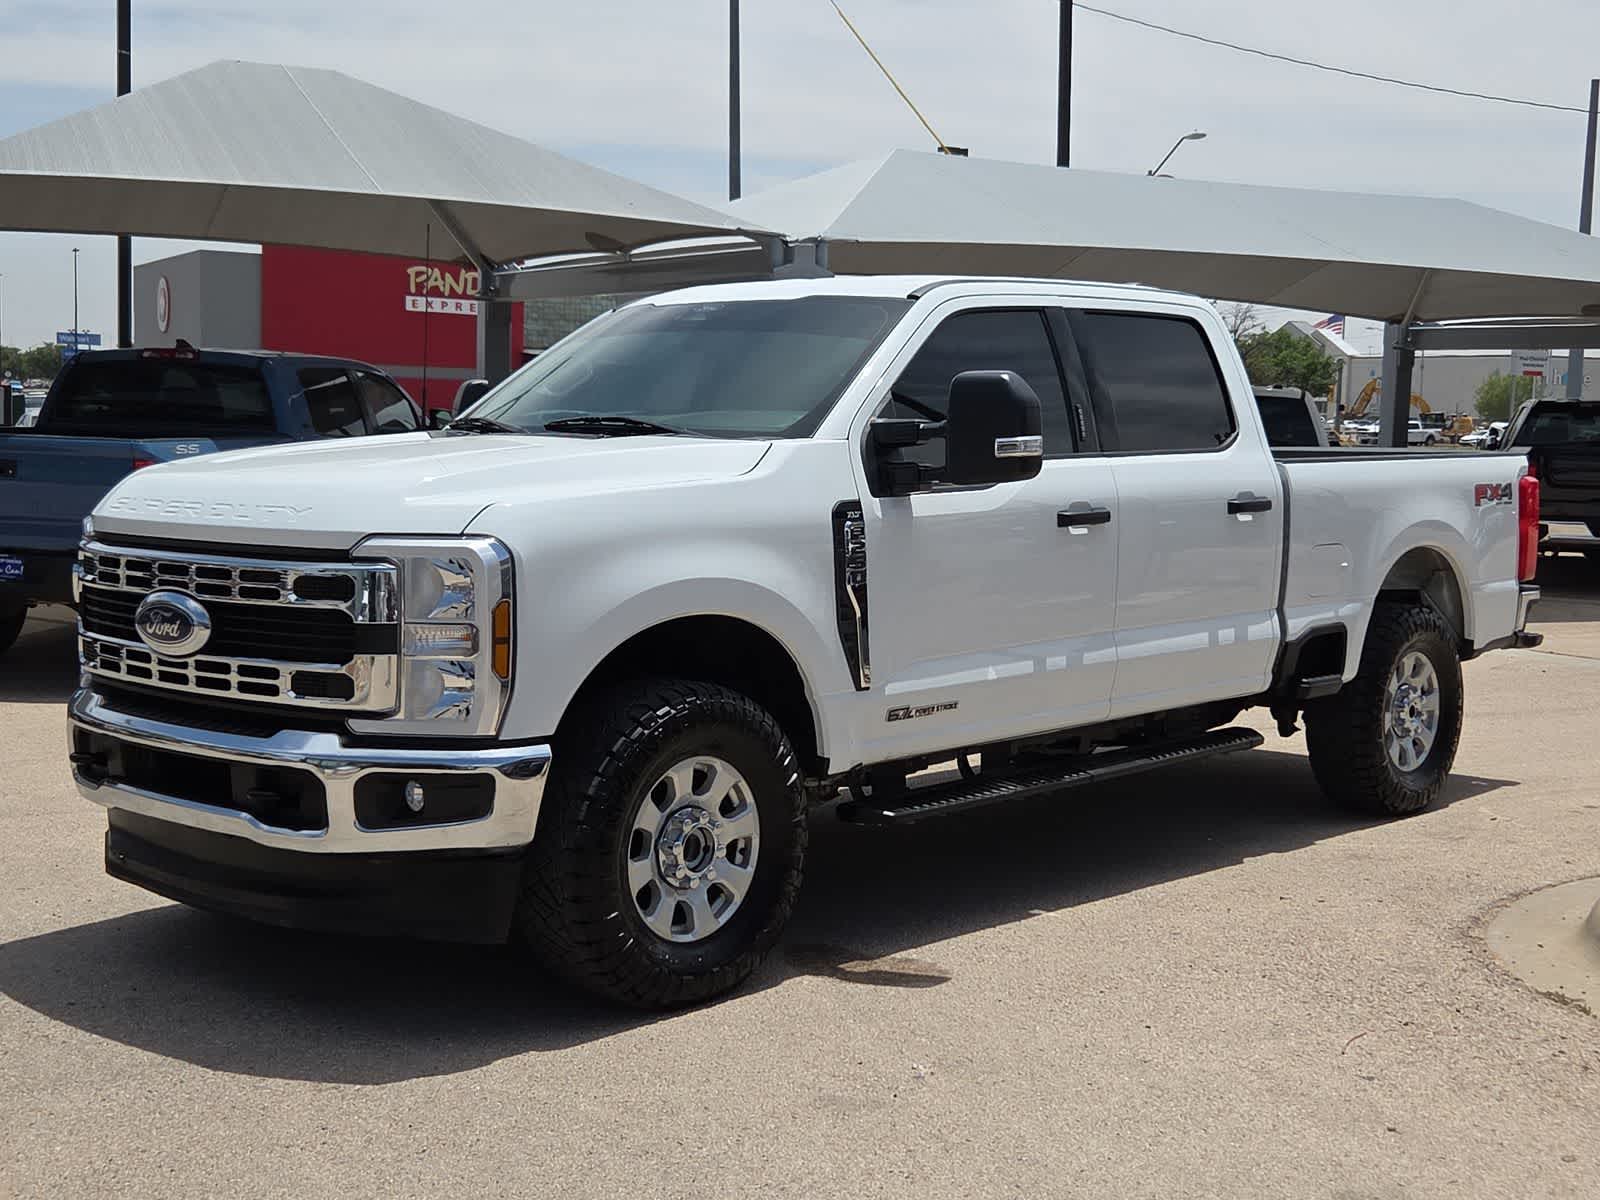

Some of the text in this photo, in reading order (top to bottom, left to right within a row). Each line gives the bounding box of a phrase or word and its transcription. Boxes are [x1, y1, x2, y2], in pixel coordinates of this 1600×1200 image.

[407, 266, 480, 296] PAND
[411, 299, 478, 313] EXPRE
[175, 444, 200, 455] SS
[1474, 483, 1513, 507] FX4
[146, 608, 181, 638] Ford
